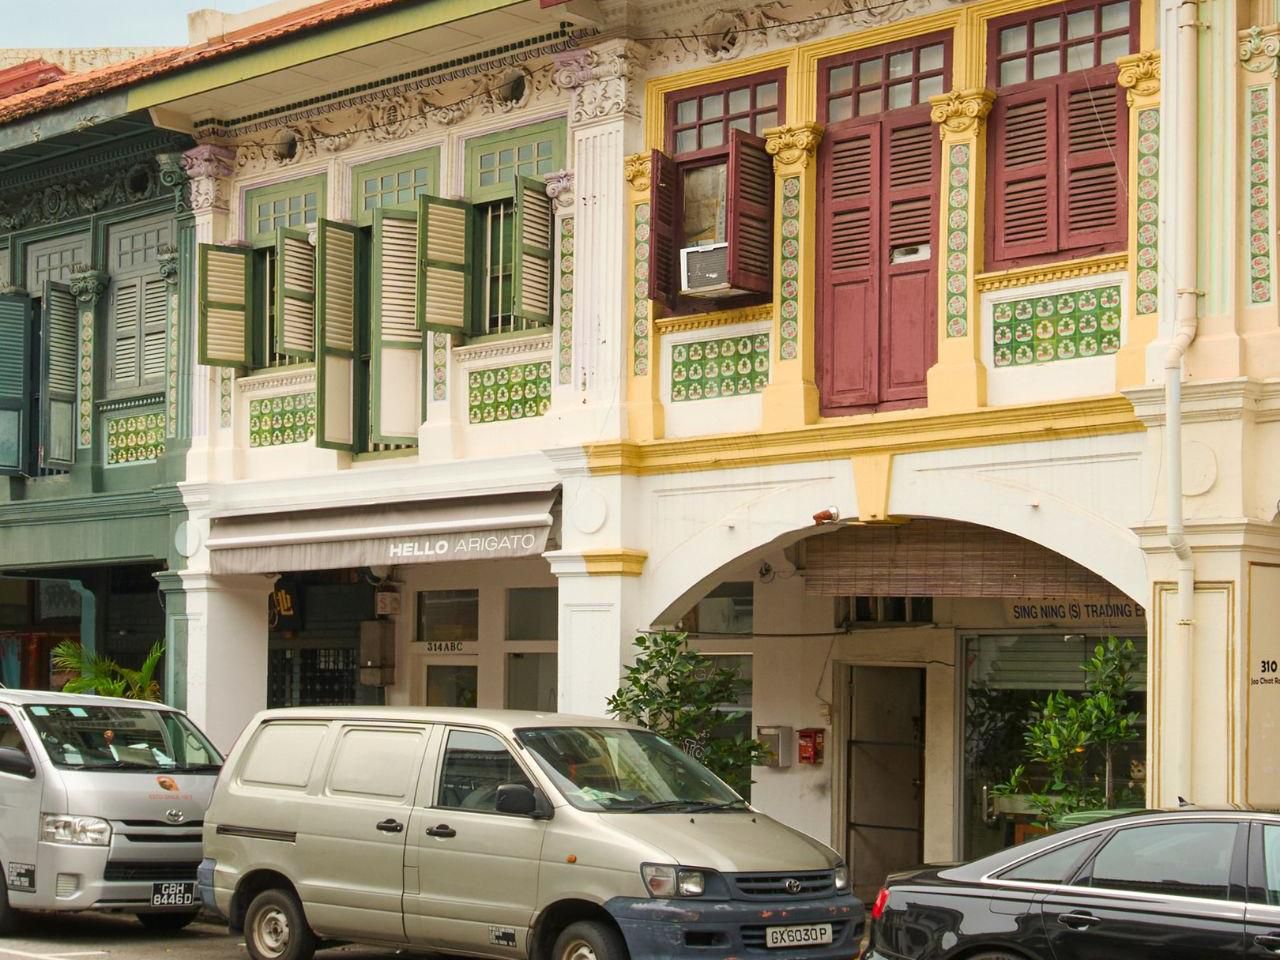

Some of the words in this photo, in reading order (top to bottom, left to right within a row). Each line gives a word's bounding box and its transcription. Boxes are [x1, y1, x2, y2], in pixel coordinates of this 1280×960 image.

[389, 540, 449, 557] HELLO
[454, 534, 535, 553] ARIGATO
[1013, 605, 1038, 619] SING
[1040, 605, 1066, 619] NING
[1068, 603, 1081, 620] (S)
[1084, 603, 1132, 618] TRADING
[427, 642, 463, 652] 314ABC
[1261, 660, 1278, 673] 310
[161, 883, 185, 894] GBH
[153, 893, 192, 905] 8446D
[771, 927, 827, 945] GX6030P
